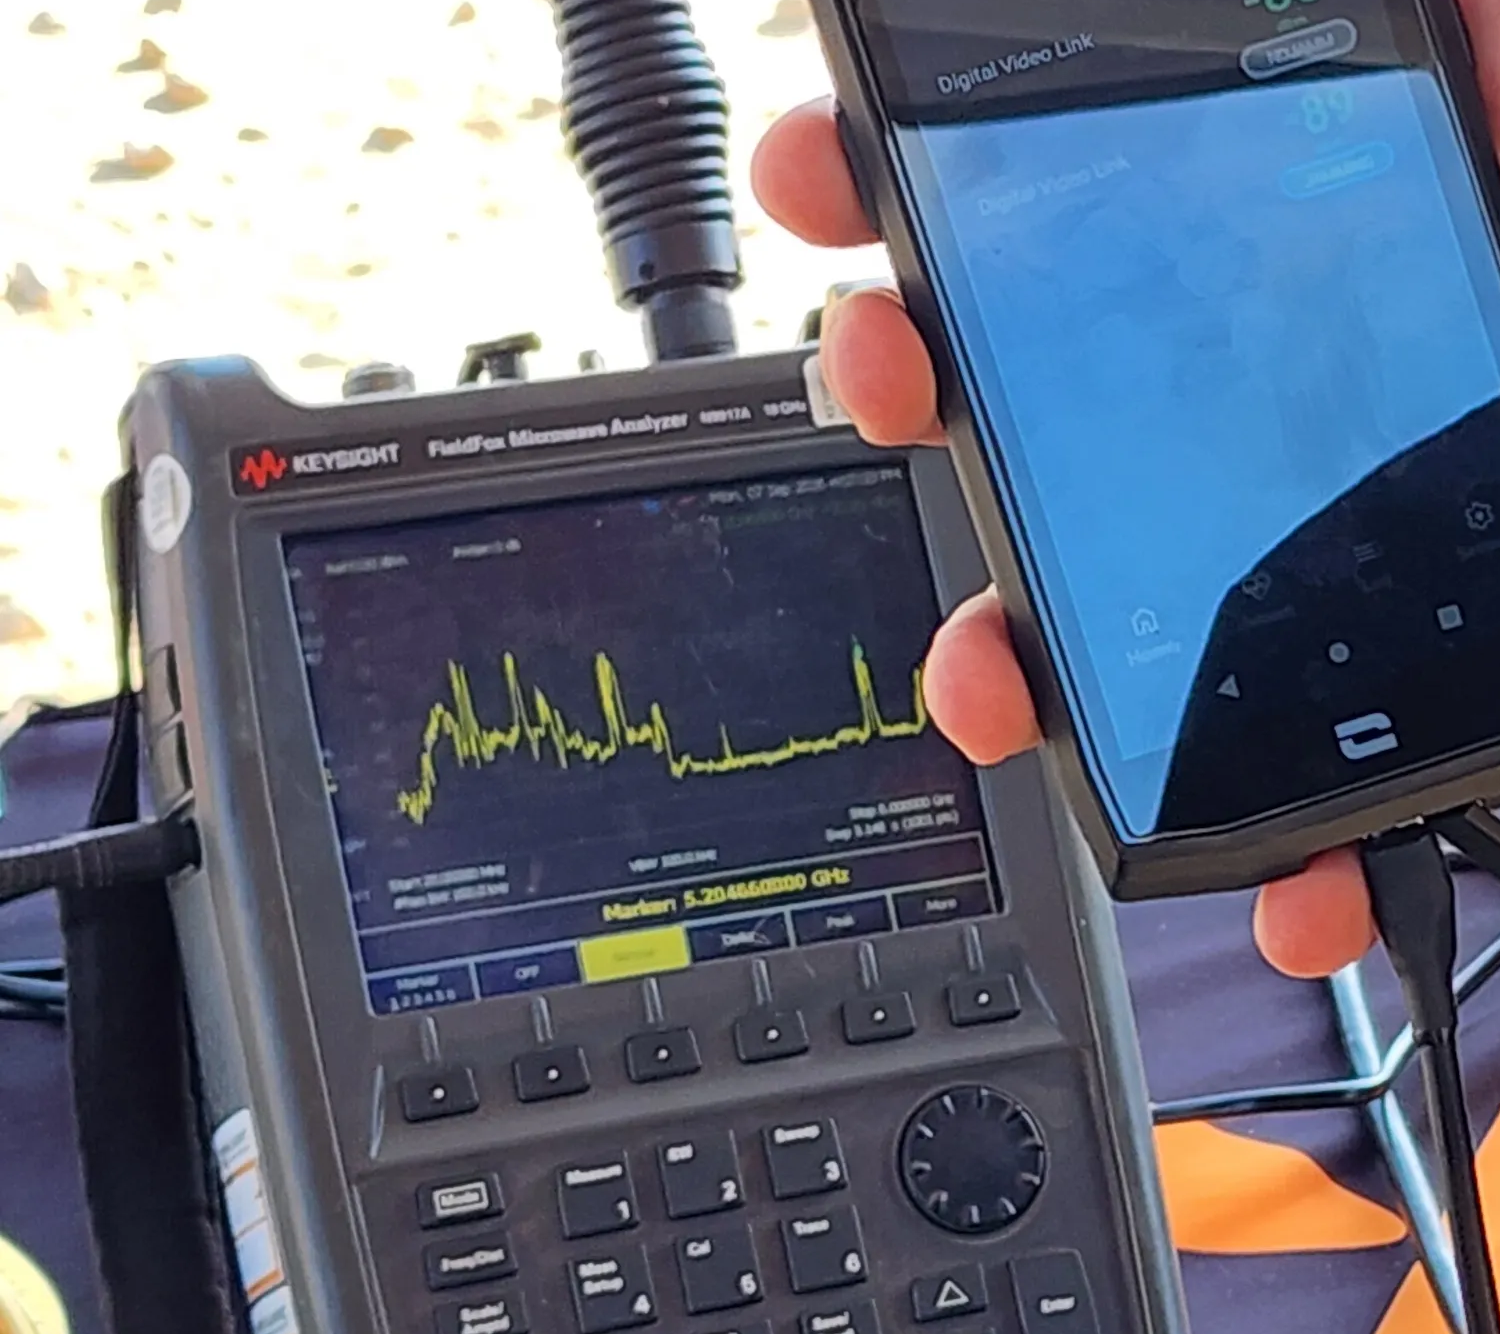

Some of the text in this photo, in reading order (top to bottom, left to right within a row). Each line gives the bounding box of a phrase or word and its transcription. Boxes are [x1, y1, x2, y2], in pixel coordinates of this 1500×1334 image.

[937, 33, 1096, 94] Digital Video Link
[292, 442, 400, 474] KEYSIGHT
[610, 413, 689, 436] Analyzer
[810, 866, 851, 887] GHz
[823, 1160, 841, 1182] 3
[720, 1179, 738, 1202] 2
[616, 1199, 631, 1220] 1
[844, 1251, 862, 1273] 6
[740, 1272, 757, 1295] 5
[632, 1293, 651, 1314] 4
